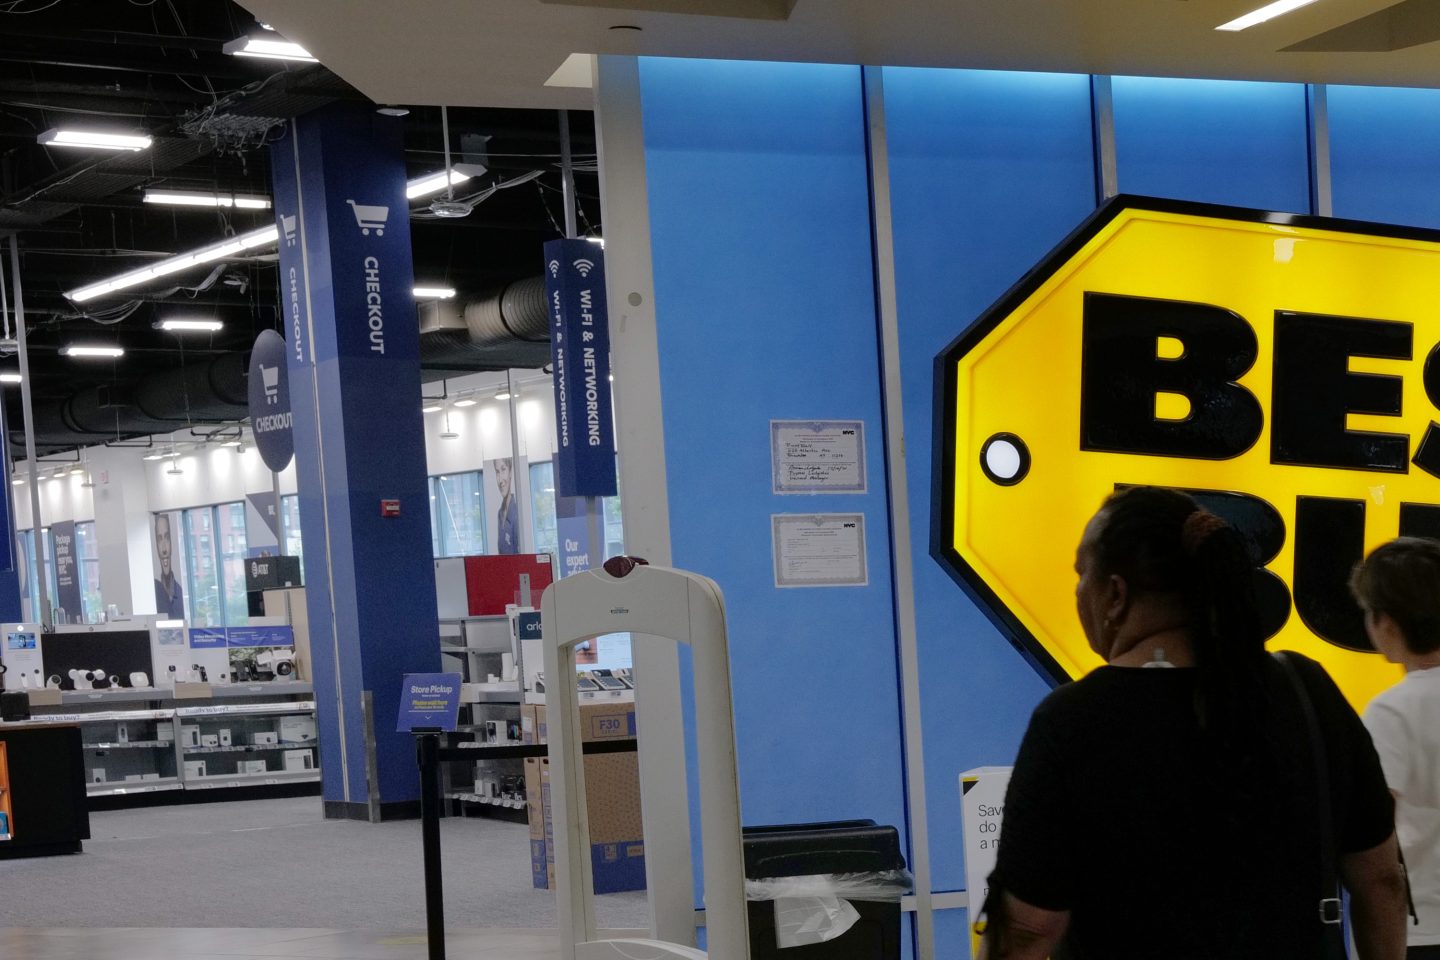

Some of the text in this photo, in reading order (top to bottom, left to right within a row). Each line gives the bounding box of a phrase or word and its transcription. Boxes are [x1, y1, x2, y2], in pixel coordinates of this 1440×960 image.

[363, 255, 386, 355] CHECKOUT
[288, 266, 304, 363] CHECKOUT
[552, 289, 562, 327] WI-FI
[557, 348, 569, 447] NETWORKING
[580, 289, 601, 446] WI-FI & NETWORKING
[255, 411, 293, 433] CHECKOUT
[565, 538, 579, 552] Our
[566, 553, 589, 568] expert
[410, 684, 453, 695] Store Pickup
[599, 719, 620, 729] F30
[979, 820, 996, 833] do
